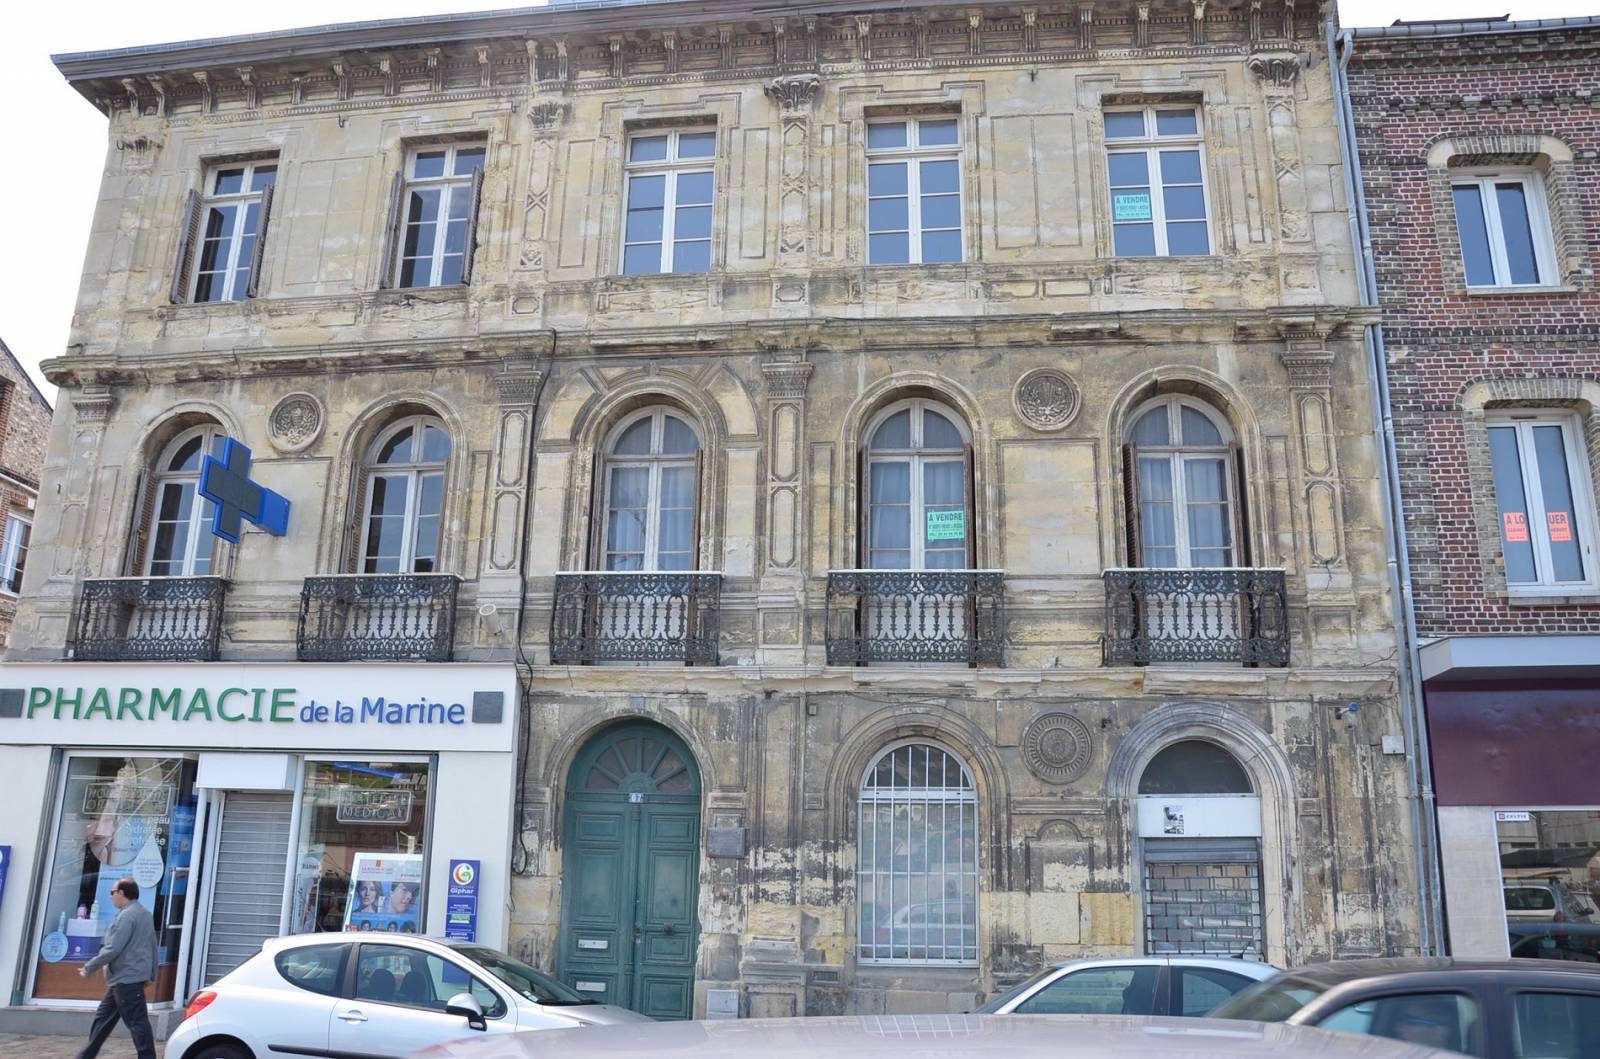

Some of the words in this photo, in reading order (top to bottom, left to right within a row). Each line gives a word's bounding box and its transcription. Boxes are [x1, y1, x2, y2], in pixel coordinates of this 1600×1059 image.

[936, 512, 962, 521] VENDRE
[1506, 515, 1513, 524] A
[1515, 514, 1525, 524] LO
[1549, 514, 1566, 524] UER
[27, 687, 296, 722] PHARMACIE
[300, 700, 328, 723] de
[334, 700, 353, 723] la
[360, 697, 466, 724] Marine
